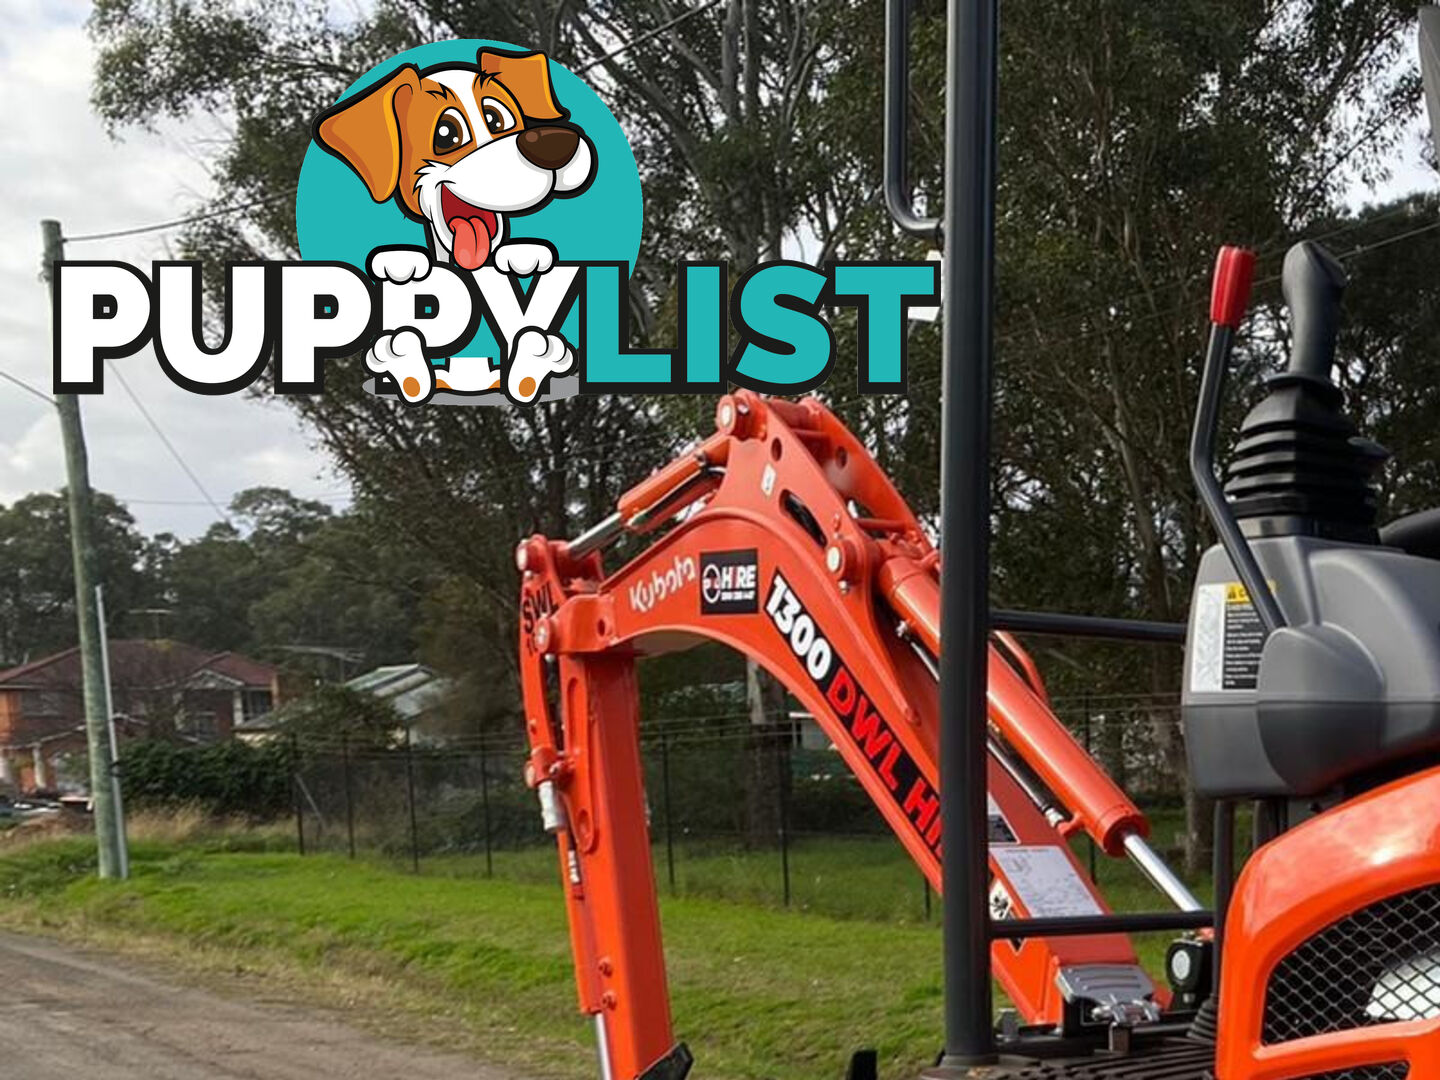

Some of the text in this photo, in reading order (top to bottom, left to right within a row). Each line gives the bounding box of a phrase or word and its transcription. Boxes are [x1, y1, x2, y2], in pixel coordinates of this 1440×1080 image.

[629, 555, 696, 612] Kubota
[721, 564, 757, 590] HIRE
[766, 574, 832, 681] 1300
[826, 667, 901, 791] DWL
